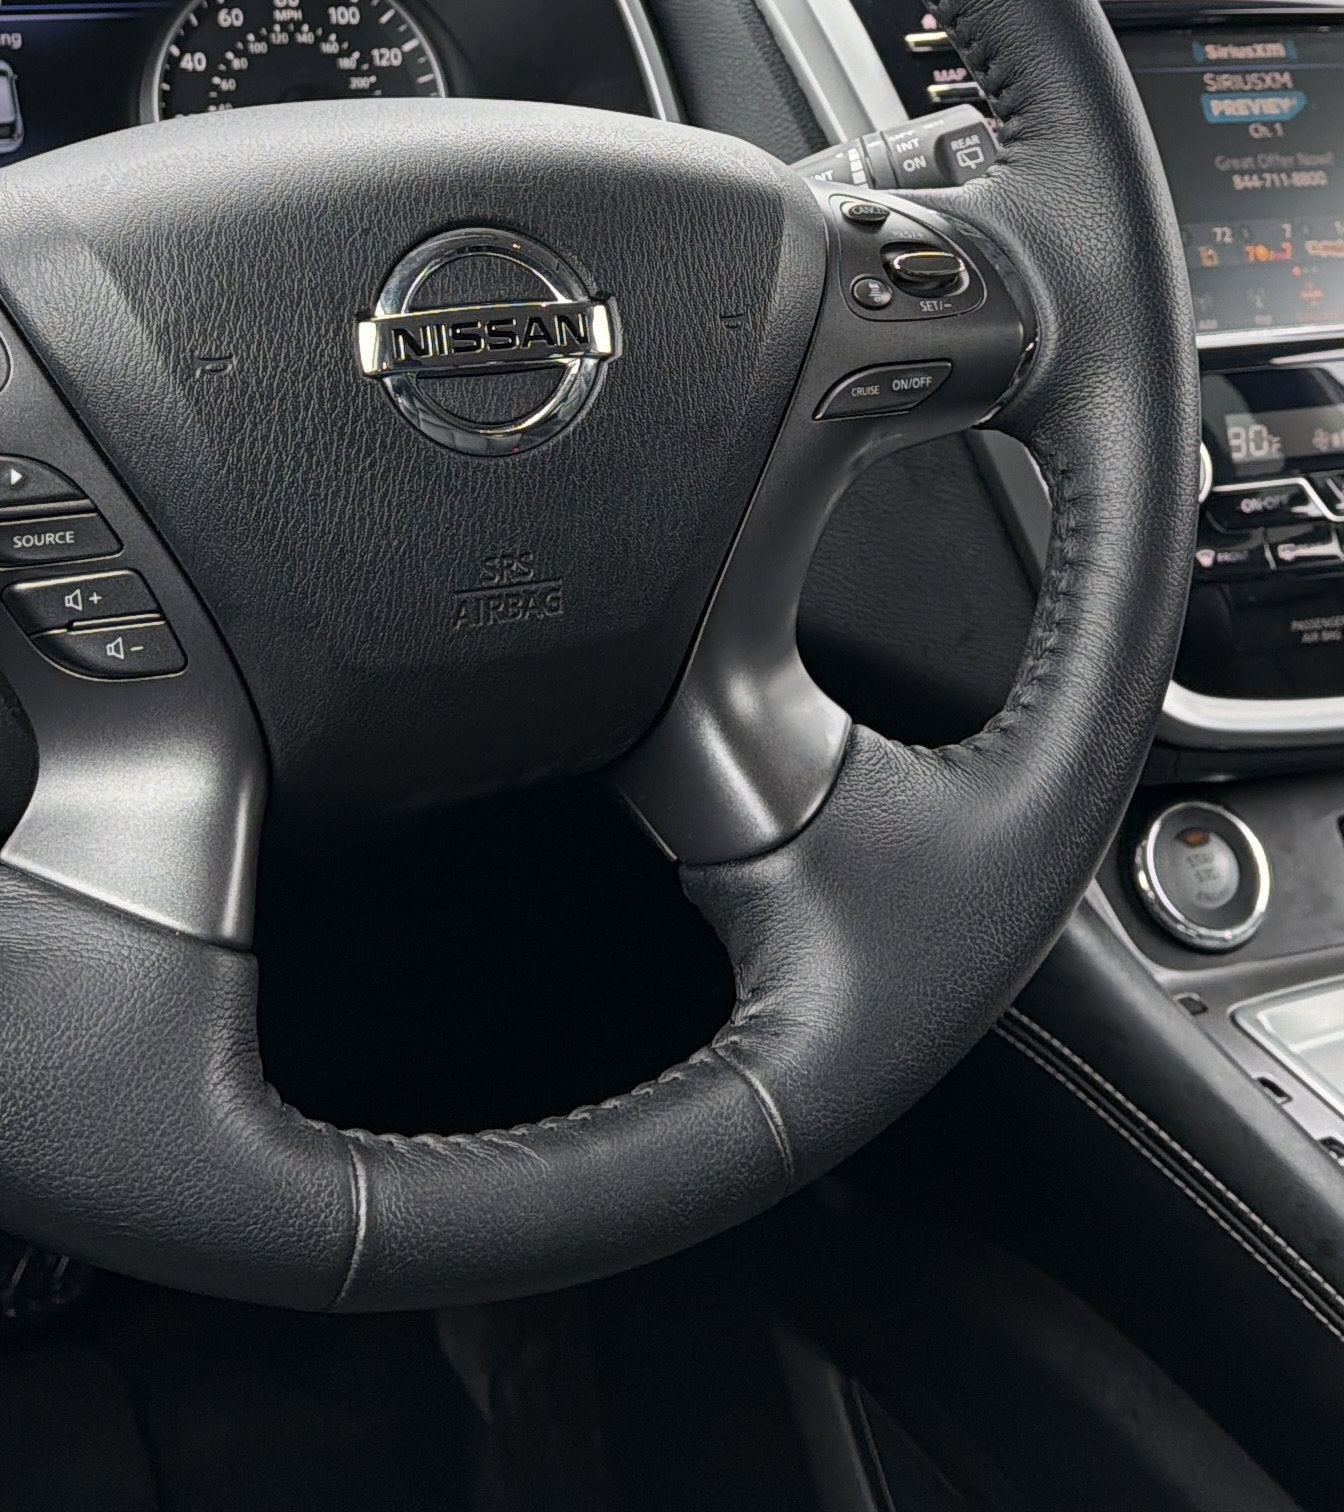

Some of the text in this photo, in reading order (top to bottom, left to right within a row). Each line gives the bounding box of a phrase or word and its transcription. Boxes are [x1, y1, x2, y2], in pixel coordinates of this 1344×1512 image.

[217, 7, 244, 28] 60
[273, 8, 302, 22] MPH
[327, 5, 360, 26] 100
[178, 51, 207, 72] 40
[370, 47, 402, 68] 120
[1209, 97, 1298, 117] PREVIEW
[895, 137, 920, 154] INT
[950, 134, 981, 151] REAR
[902, 155, 927, 172] ON
[390, 312, 589, 361] NISSAN
[850, 376, 933, 397] CRUISE ON/OFF
[12, 530, 76, 549] SOURCE
[454, 589, 564, 630] AIRBAG
